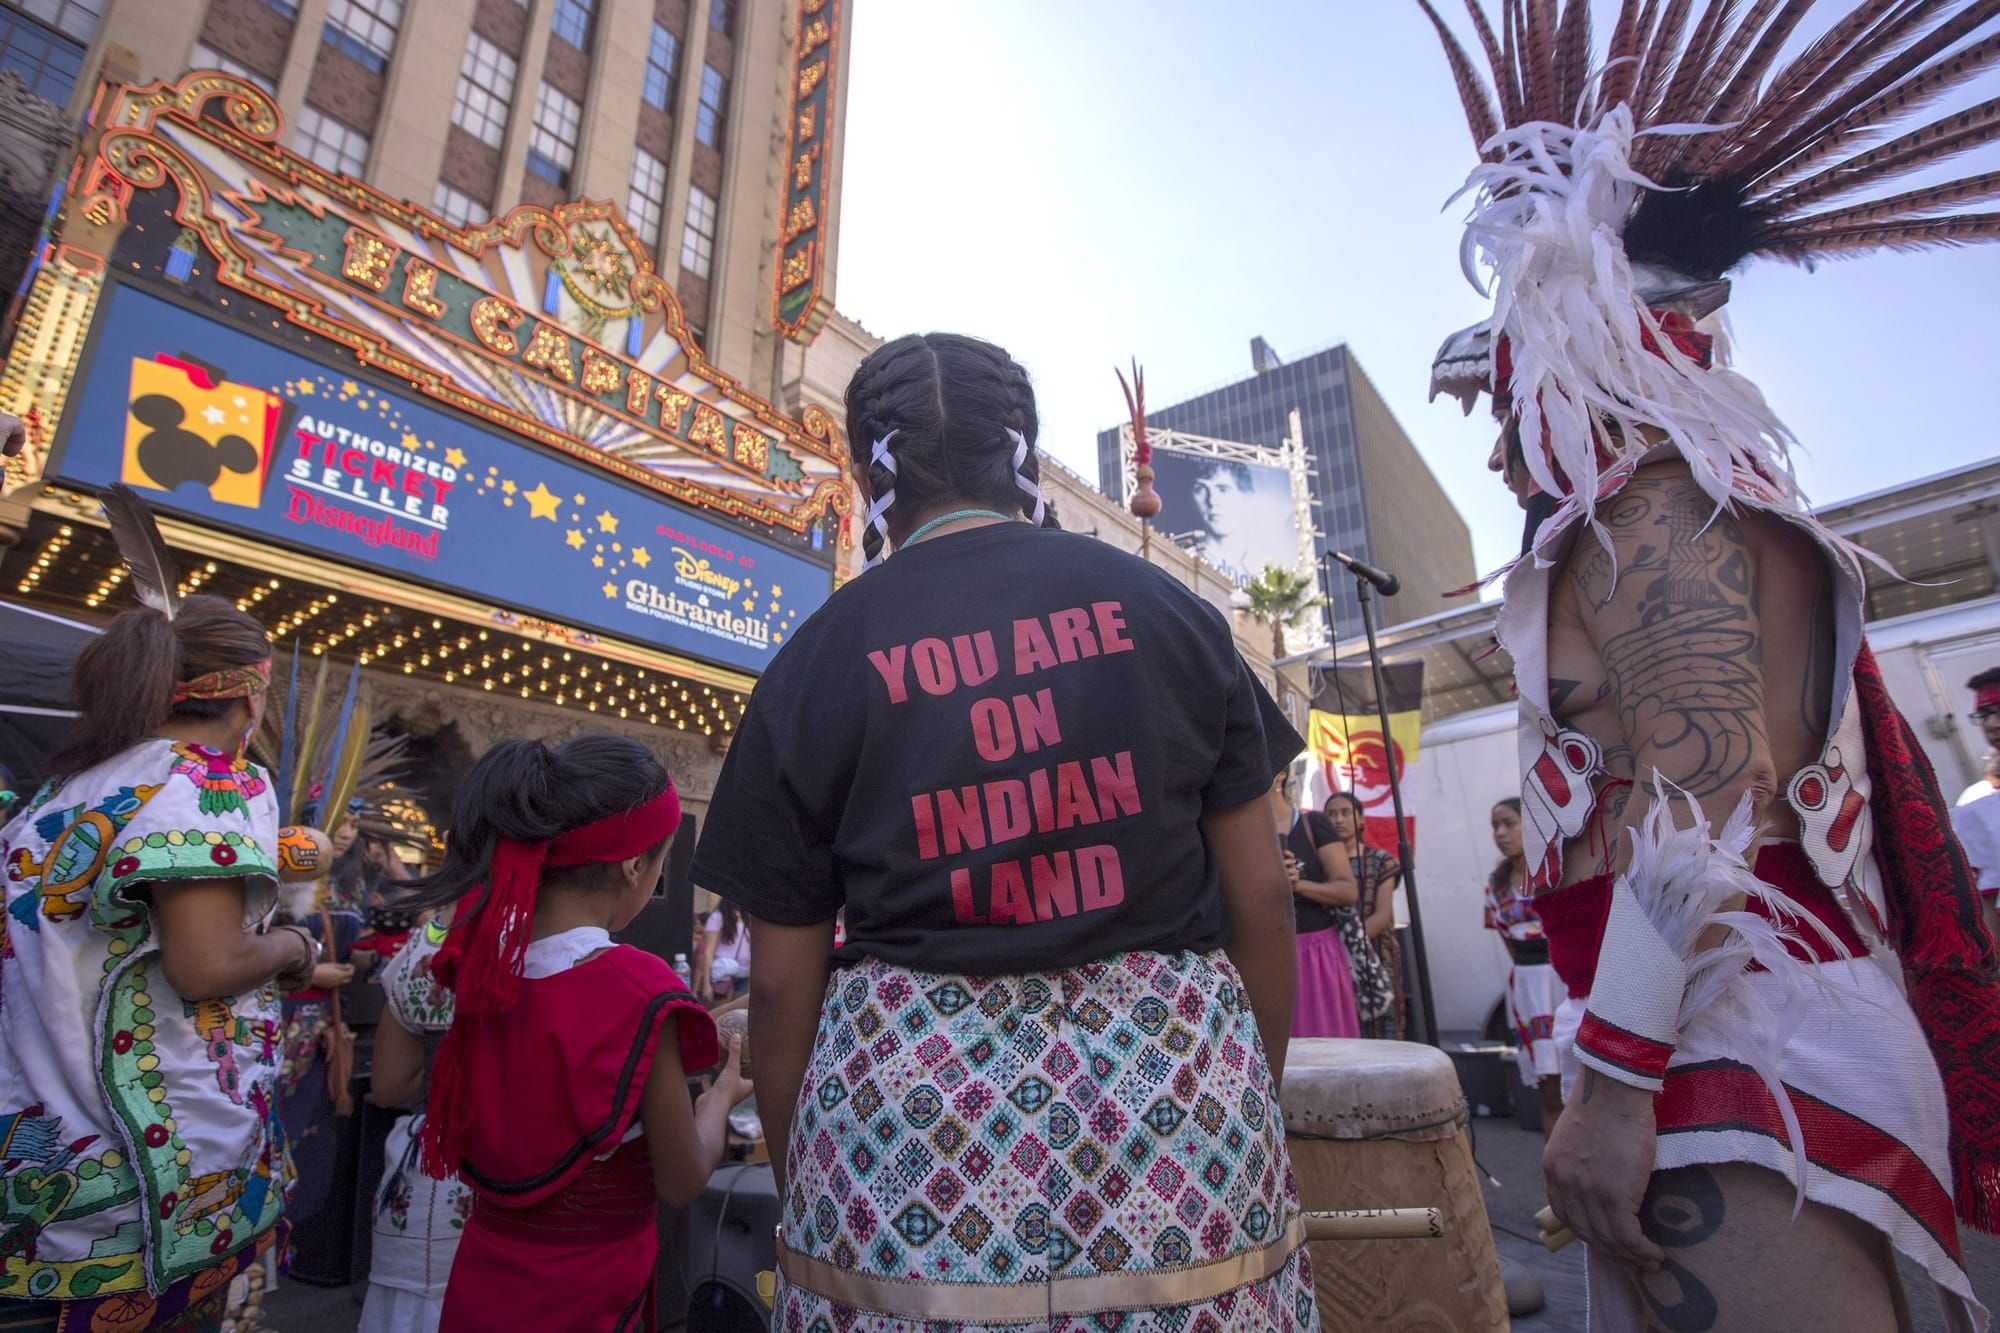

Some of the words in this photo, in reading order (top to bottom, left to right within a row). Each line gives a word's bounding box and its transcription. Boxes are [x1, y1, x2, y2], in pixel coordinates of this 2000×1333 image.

[342, 226, 447, 320] EL
[470, 297, 769, 473] CAPITAN
[295, 429, 454, 504] TICKET
[297, 415, 457, 483] AUTHORIZED
[281, 484, 439, 560] Disneyland
[291, 458, 449, 524] SELLER
[625, 601, 649, 615] SODA
[649, 608, 689, 627] FOUNTAIN
[688, 619, 705, 632] AND
[705, 626, 748, 645] CHOCOLATE
[748, 639, 769, 650] SHOP
[626, 579, 768, 643] Ghirardelli
[674, 576, 702, 592] STUDIO
[702, 585, 727, 600] STORE
[698, 594, 710, 607] &
[866, 630, 999, 704] YOU
[1012, 600, 1134, 676] ARE
[970, 687, 1062, 762] ON
[911, 750, 1142, 860] INDIAN
[950, 844, 1125, 925] LAND
